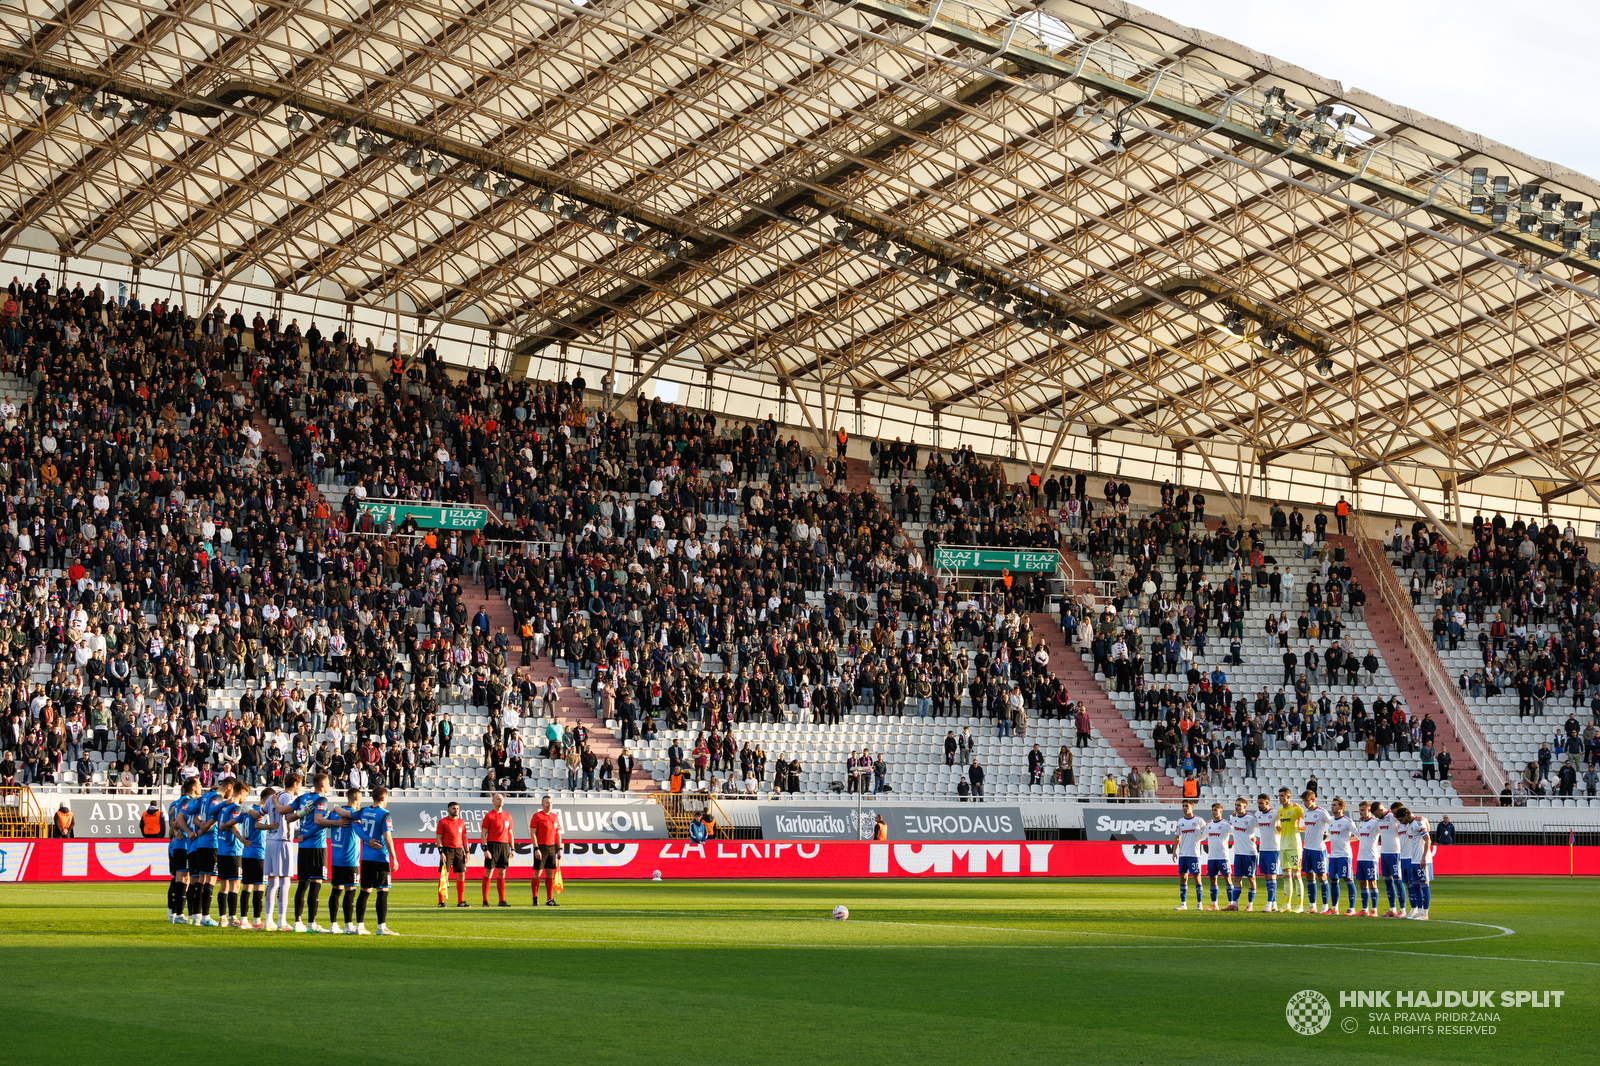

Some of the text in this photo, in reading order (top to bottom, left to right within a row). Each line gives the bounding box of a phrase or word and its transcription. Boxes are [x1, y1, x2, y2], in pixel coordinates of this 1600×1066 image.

[357, 504, 388, 514] ZLAZ
[357, 513, 383, 522] EIT
[450, 510, 483, 518] IZLAZ
[452, 518, 478, 527] EXIT
[940, 551, 972, 560] IZLAZ
[1022, 554, 1054, 562] IZLAZ
[942, 559, 968, 567] EXIT
[1026, 562, 1050, 570] EXIT
[564, 811, 654, 832] LUKOIL
[776, 814, 846, 834] Karlovačko
[904, 816, 1012, 833] EURODAUS
